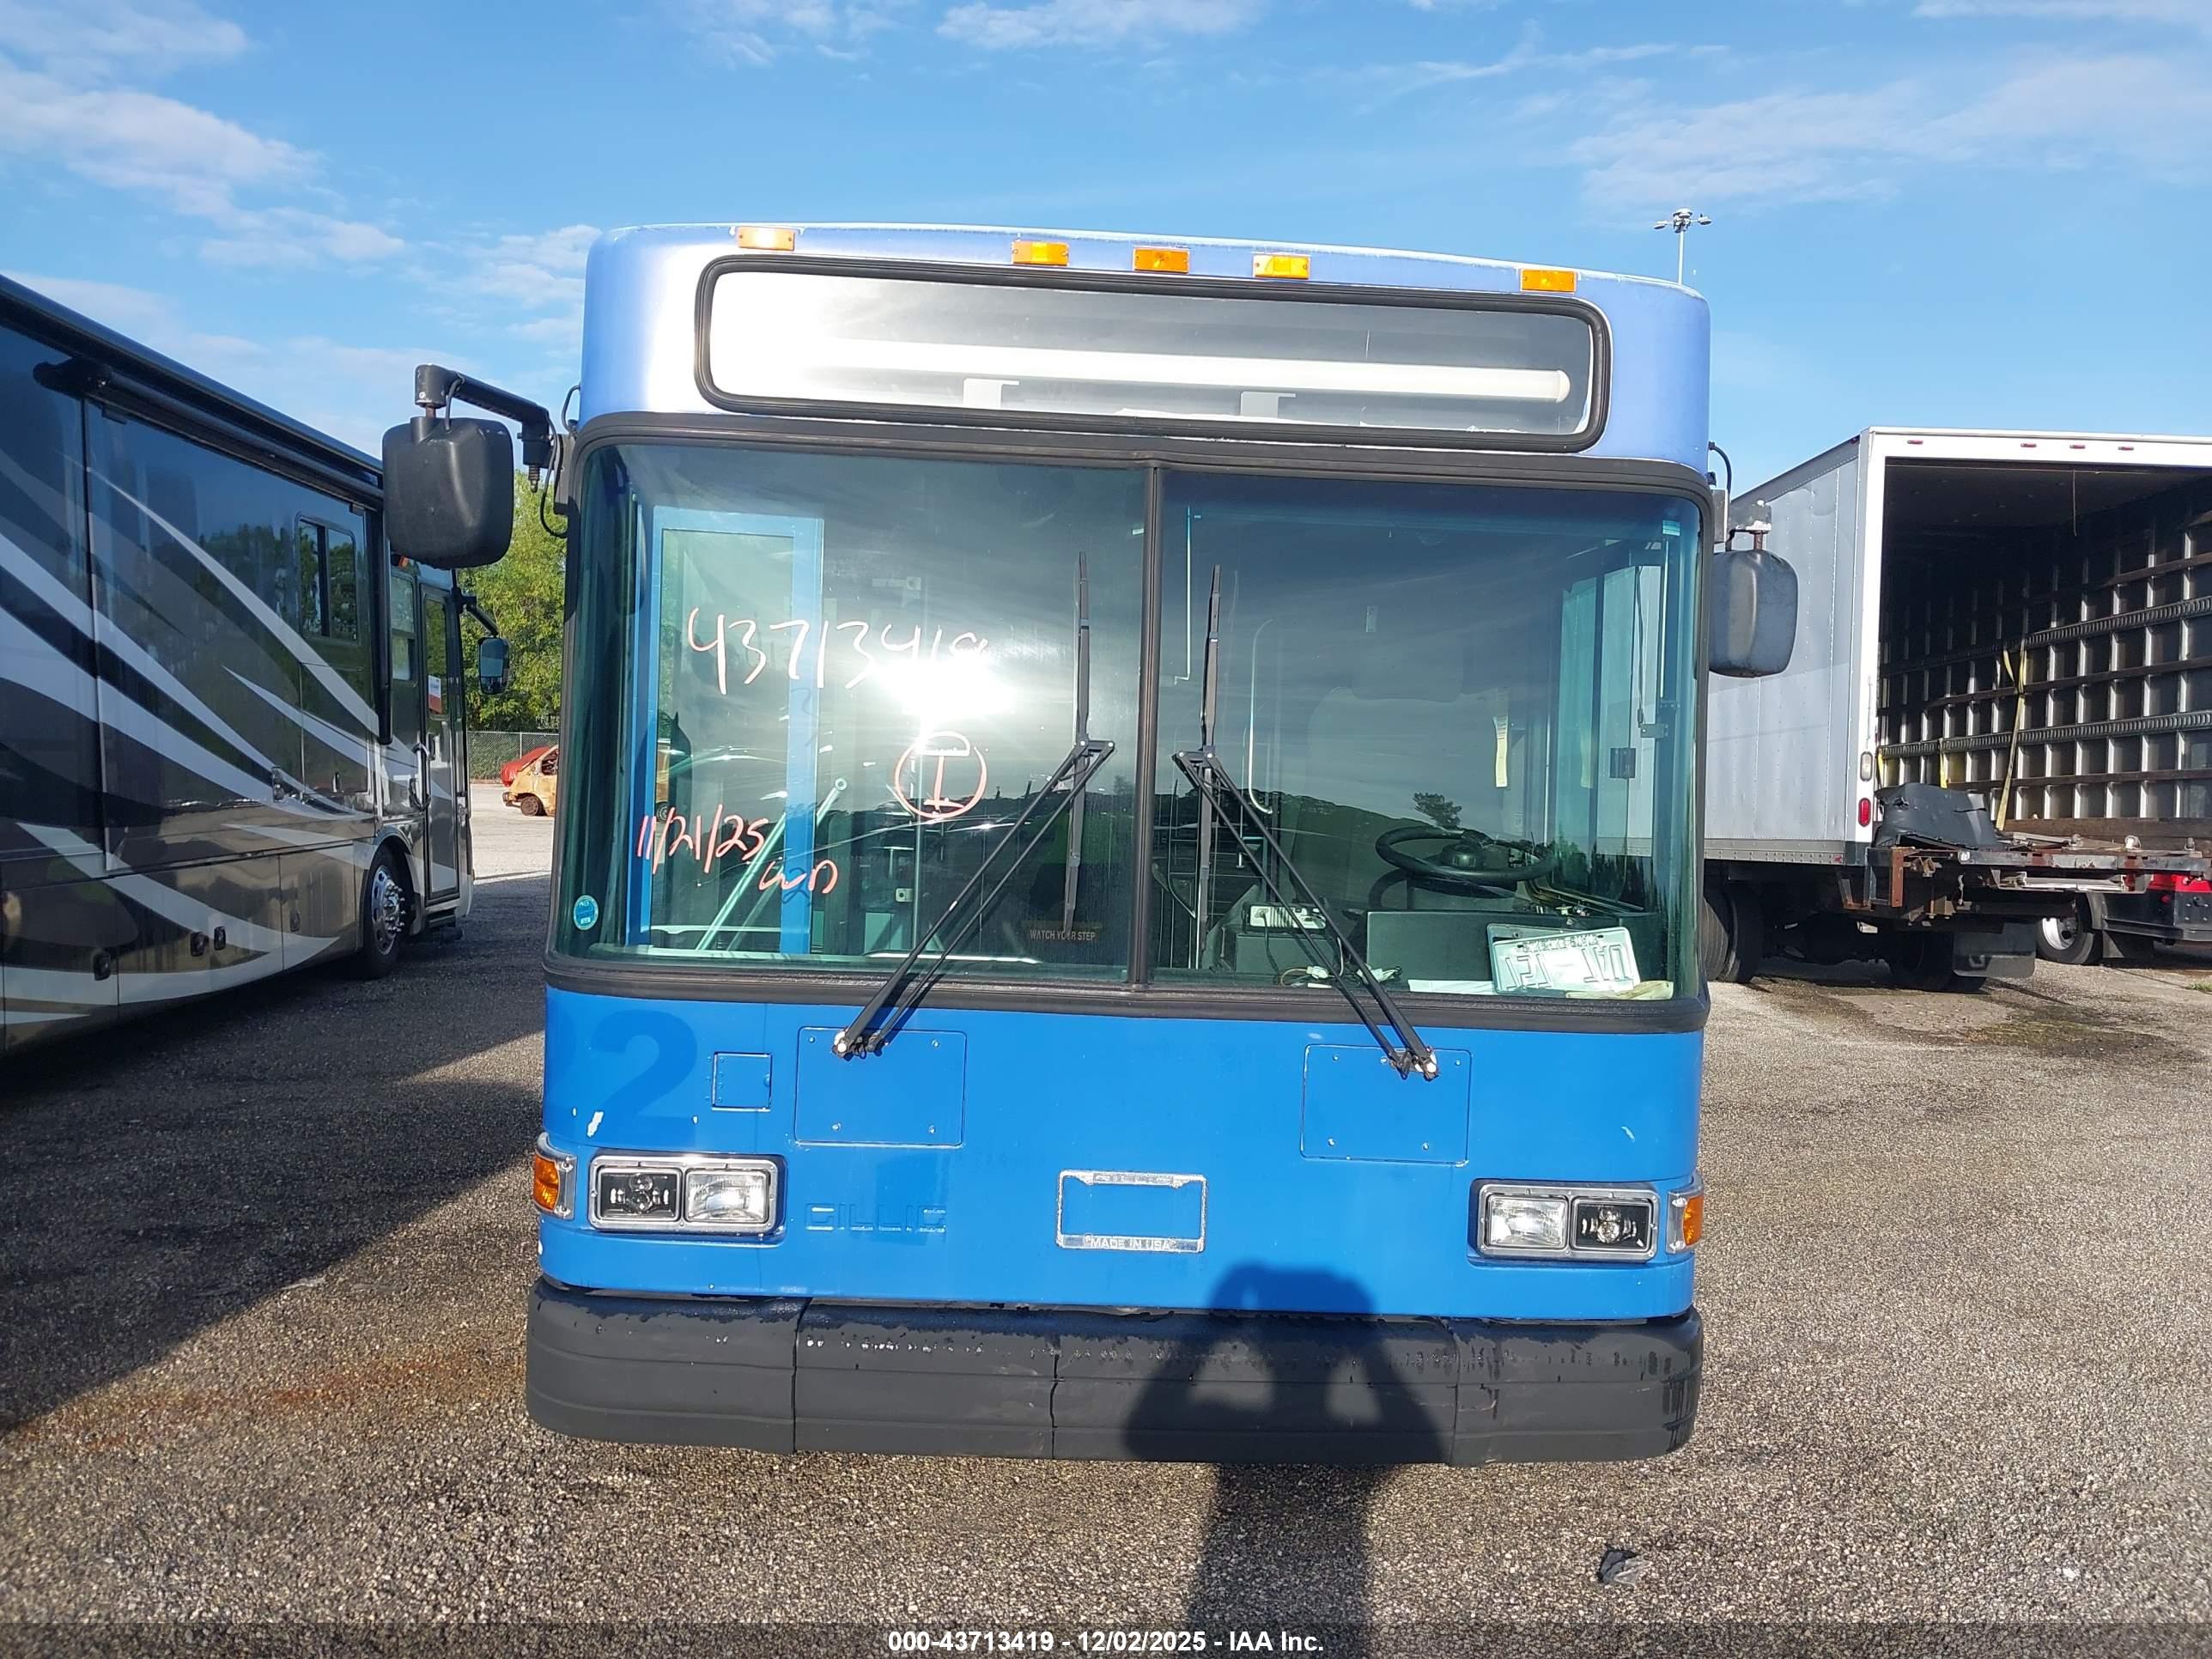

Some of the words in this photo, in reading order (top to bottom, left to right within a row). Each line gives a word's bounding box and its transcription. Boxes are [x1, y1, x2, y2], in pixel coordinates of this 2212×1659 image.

[637, 803, 769, 875] 11/21/25
[1030, 929, 1055, 940] WATCH
[1056, 930, 1077, 940] YOR
[1077, 931, 1096, 941] STEP
[805, 1202, 947, 1234] GILLIG
[1091, 1237, 1126, 1249] MADE
[1128, 1238, 1142, 1249] IN
[1145, 1239, 1171, 1251] USA
